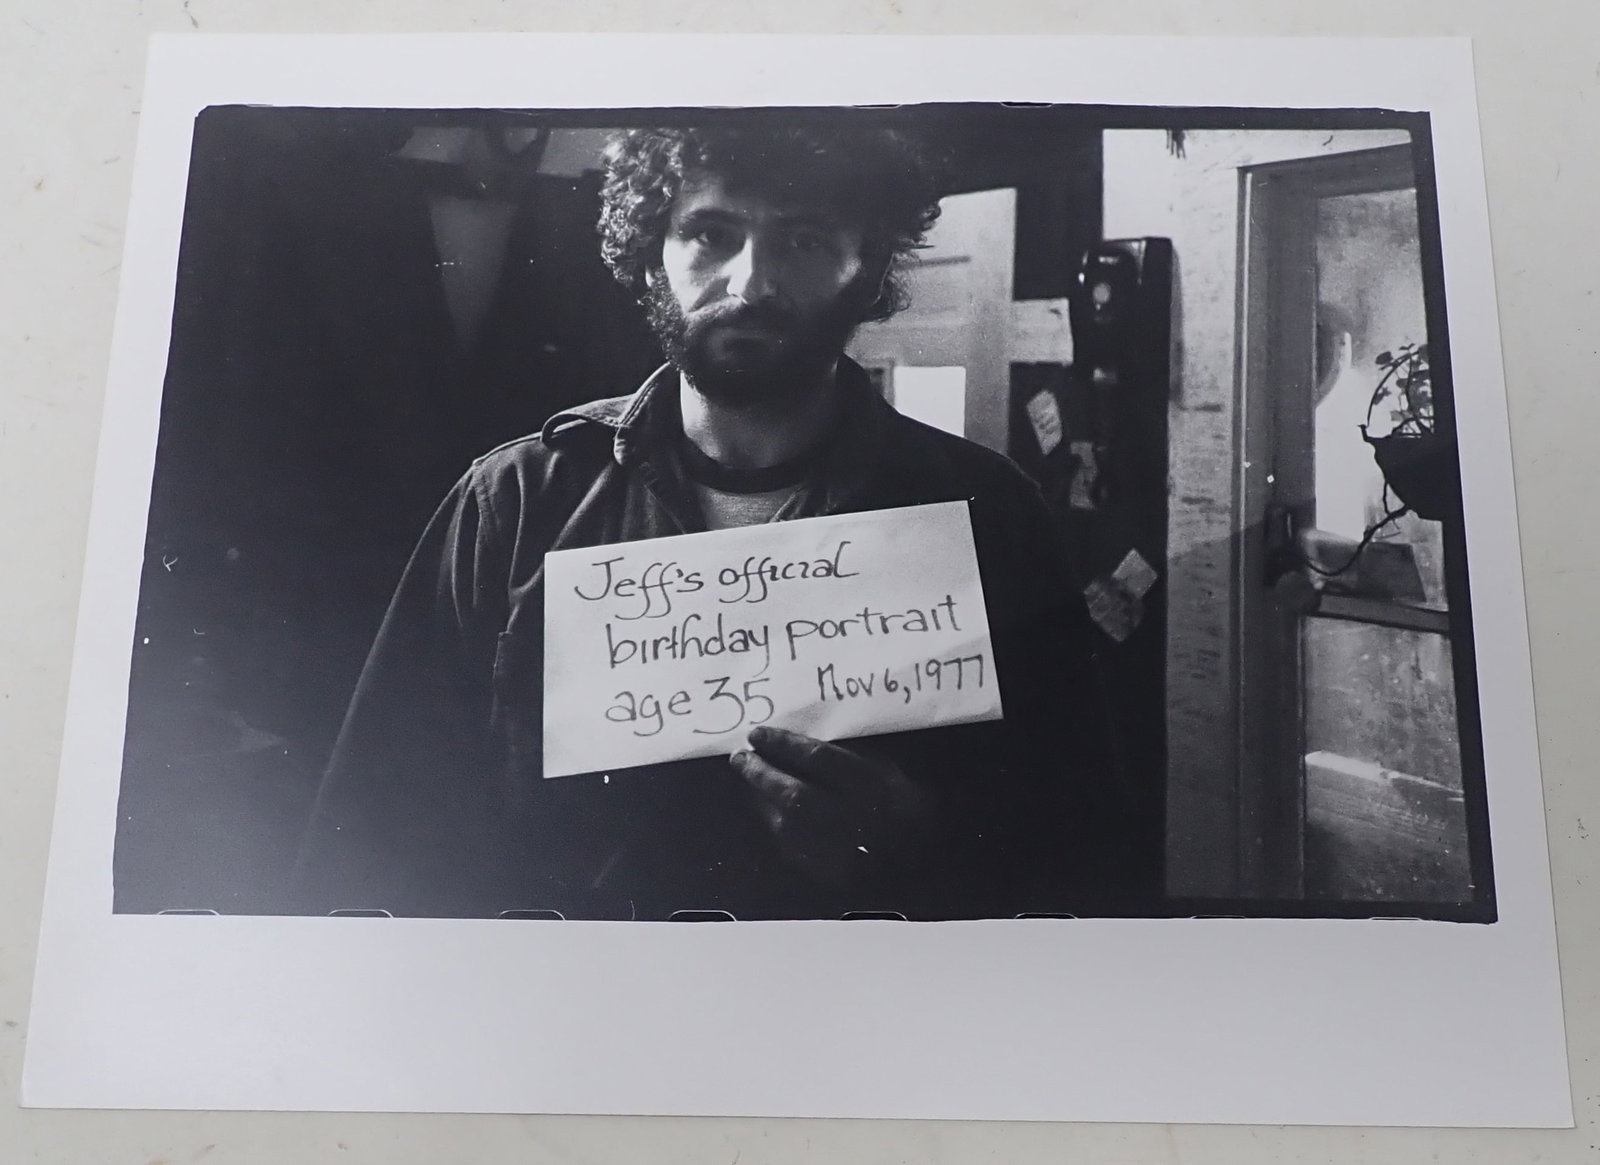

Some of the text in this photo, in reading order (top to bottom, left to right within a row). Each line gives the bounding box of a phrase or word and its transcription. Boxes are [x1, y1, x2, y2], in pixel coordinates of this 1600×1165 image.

[574, 541, 860, 620] Jeff's official
[605, 595, 963, 677] birthday portrait
[604, 689, 693, 737] age
[692, 676, 775, 734] 35
[817, 664, 876, 702] Nov
